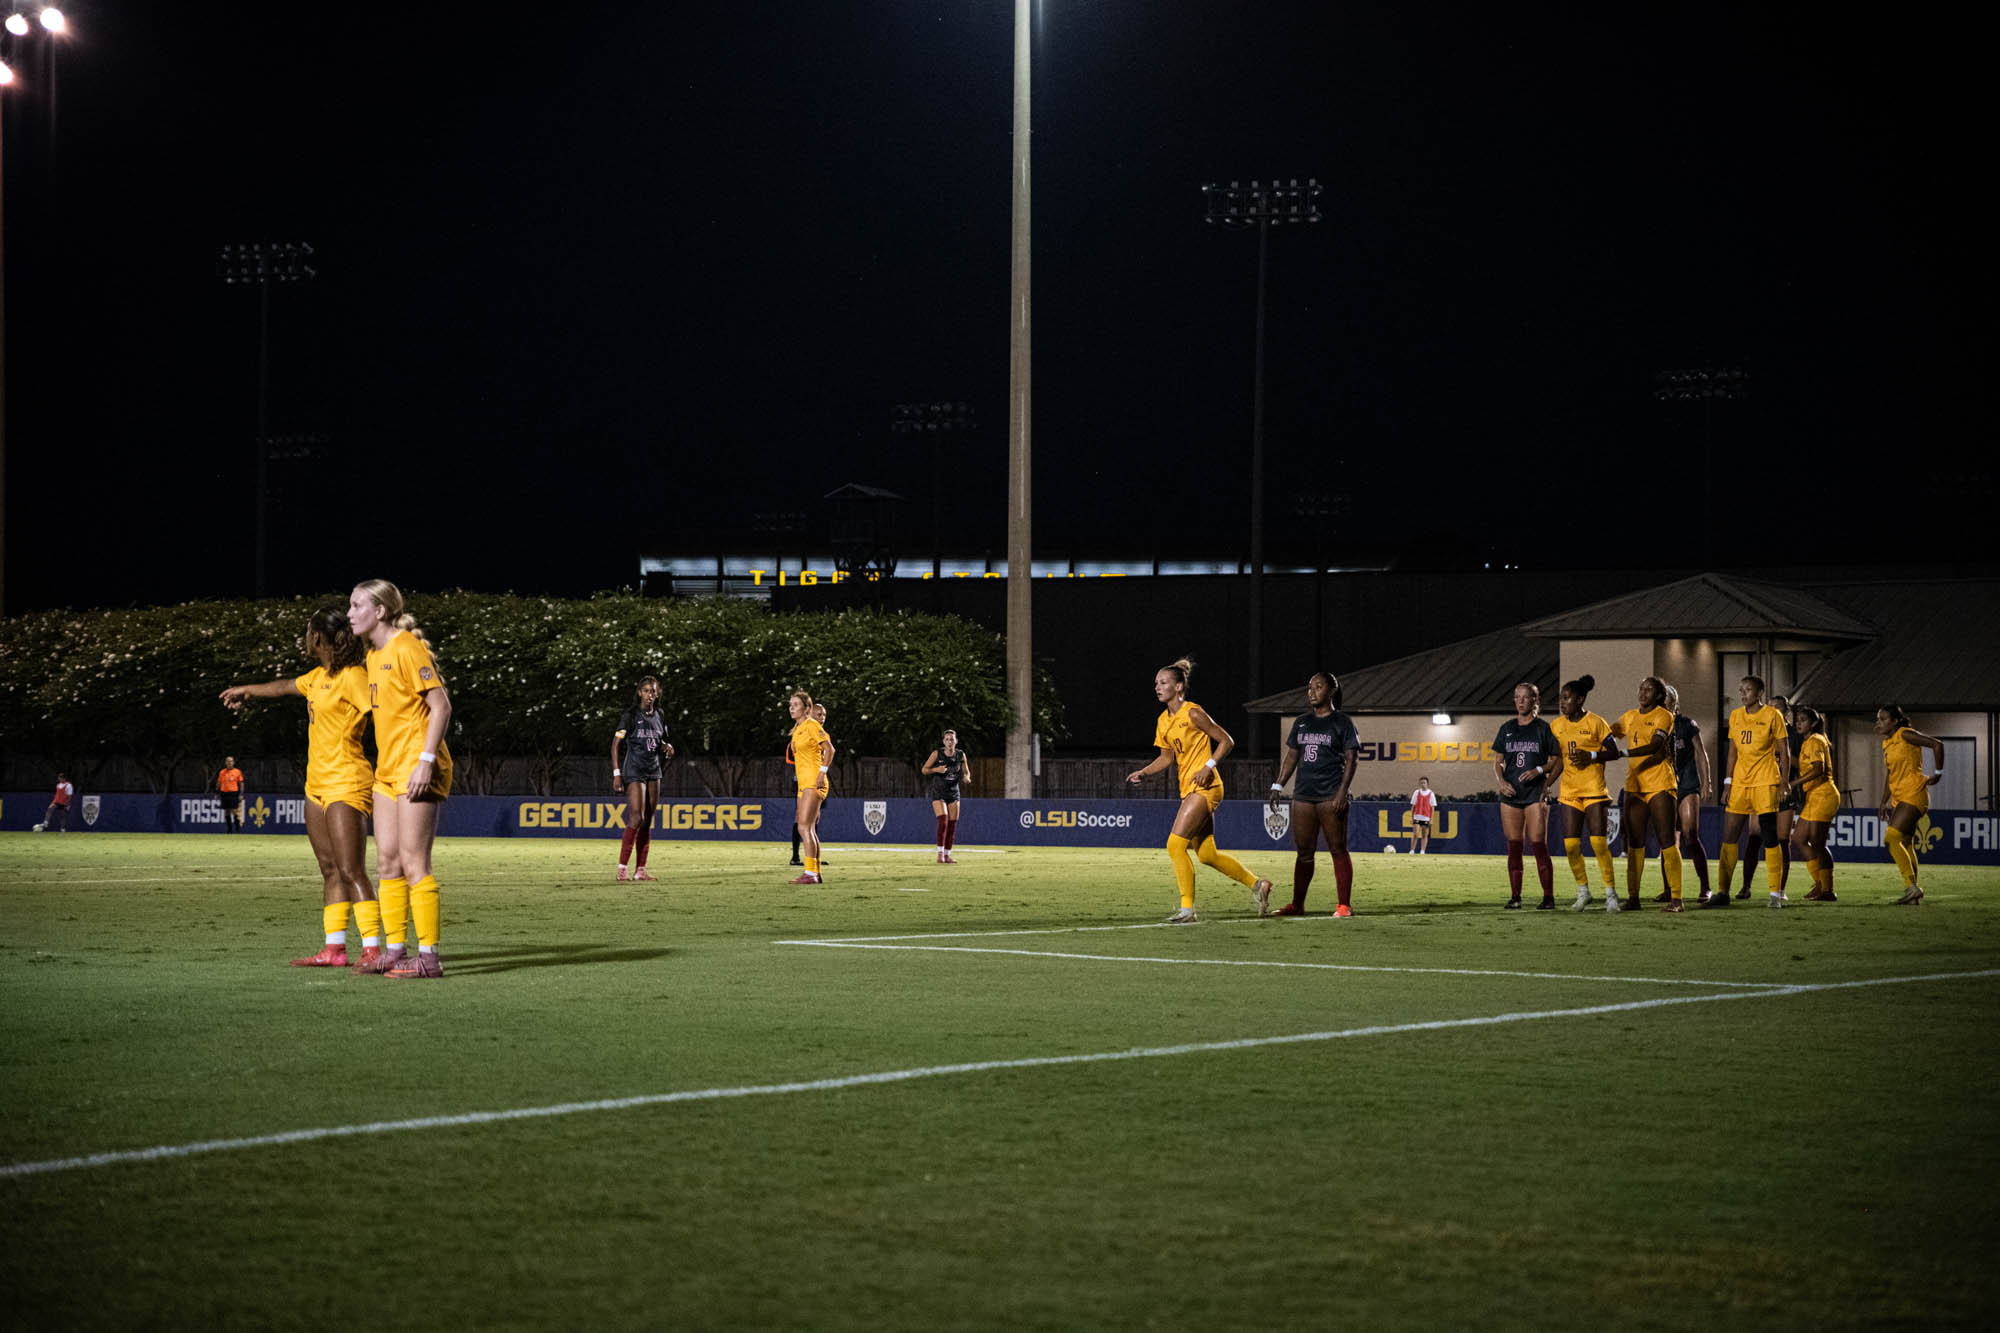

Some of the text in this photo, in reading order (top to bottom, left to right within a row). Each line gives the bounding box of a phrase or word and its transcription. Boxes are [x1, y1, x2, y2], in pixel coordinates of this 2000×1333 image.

[1740, 730, 1752, 745] 20
[1303, 744, 1319, 762] 15
[1515, 752, 1526, 768] 6
[519, 803, 627, 828] GEAUX
[1019, 810, 1132, 828] @LSUSoccer
[1953, 816, 2000, 849] PRI
